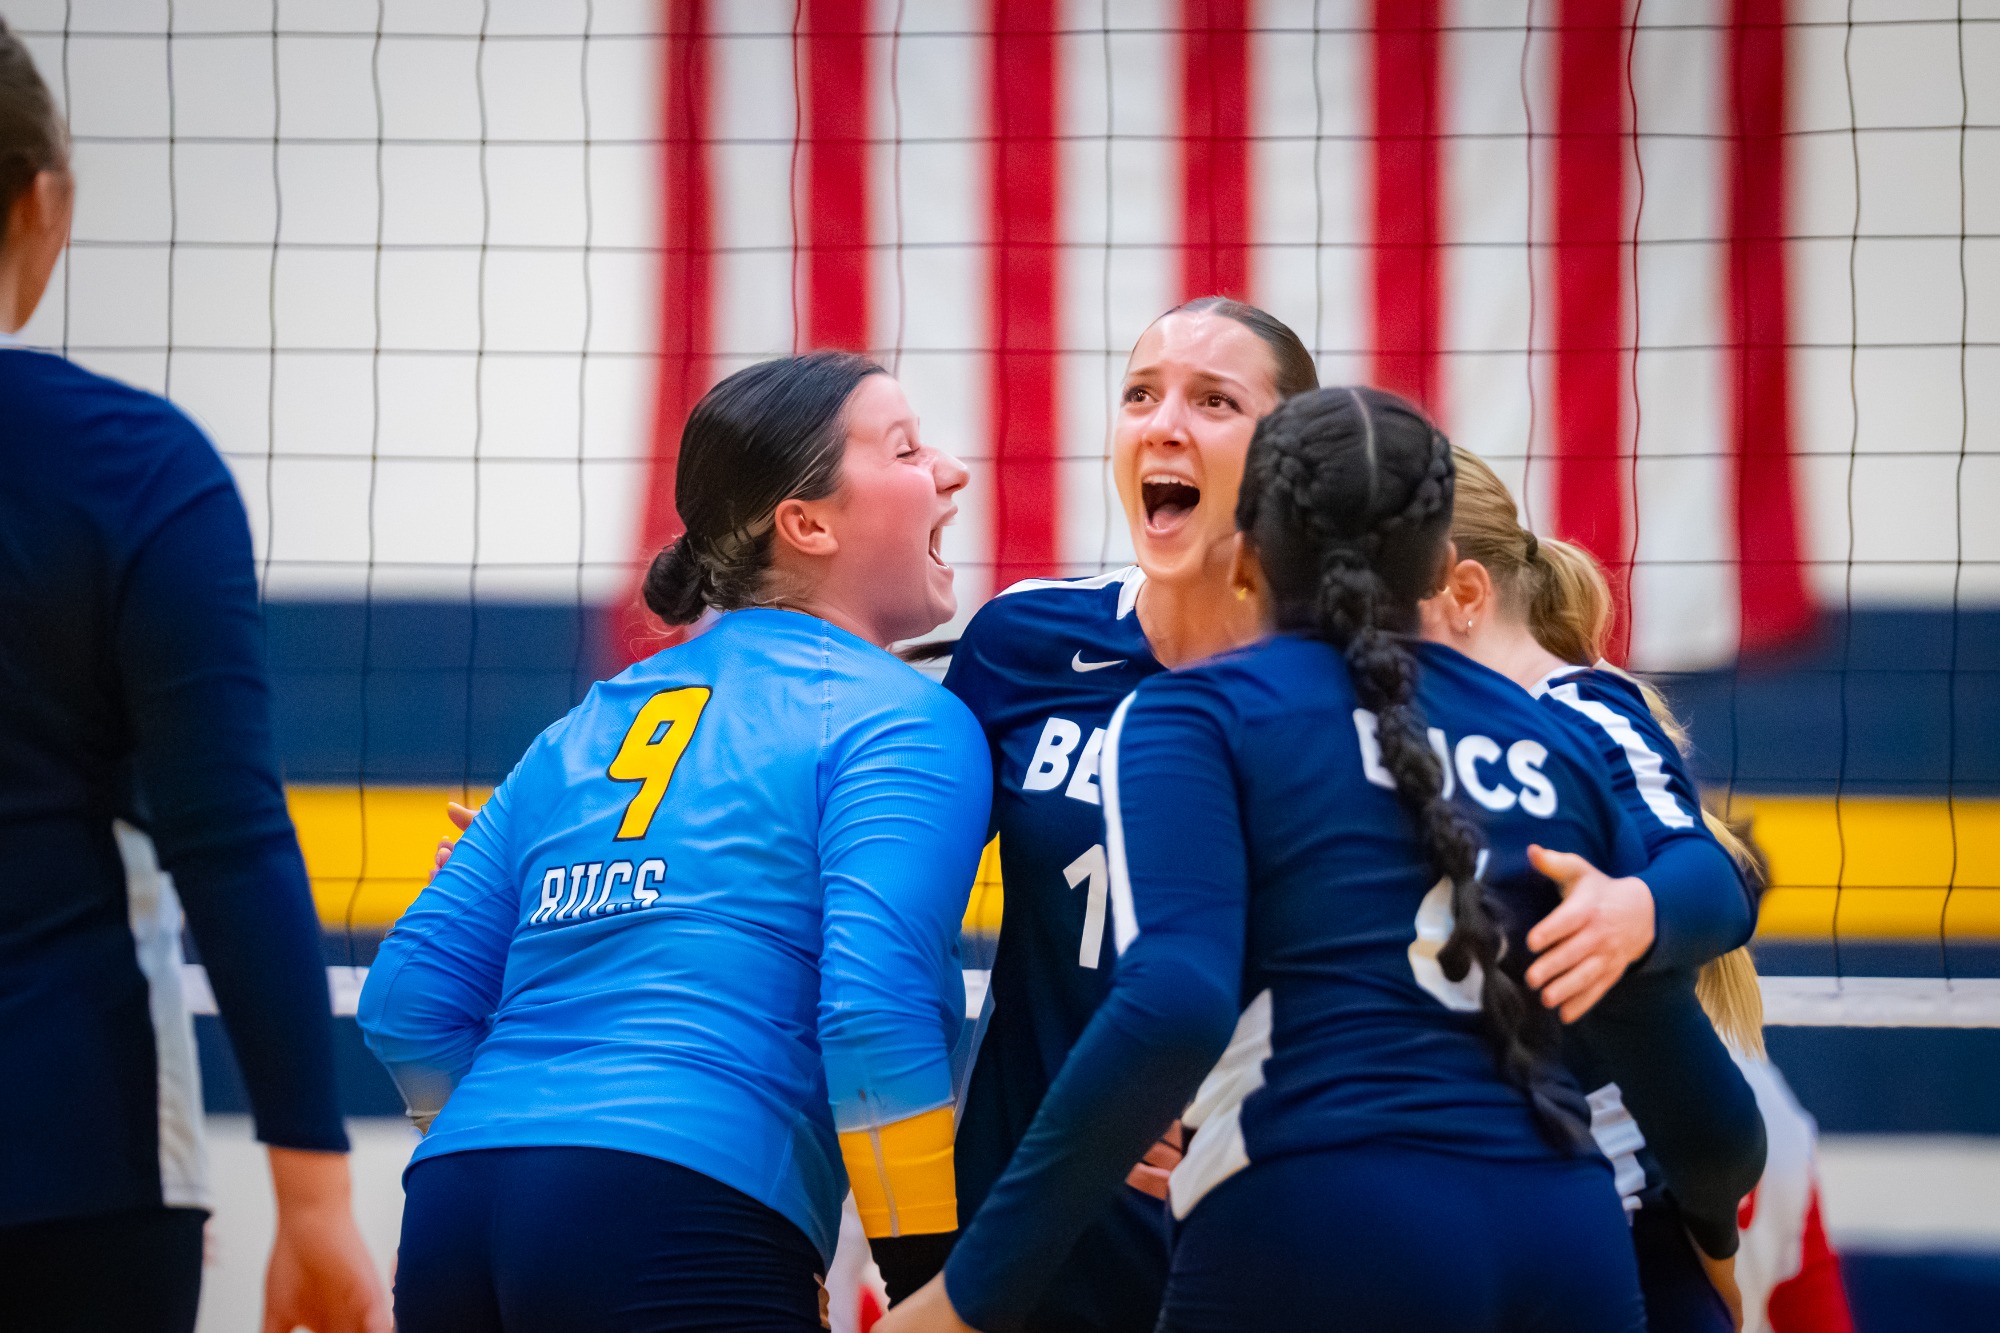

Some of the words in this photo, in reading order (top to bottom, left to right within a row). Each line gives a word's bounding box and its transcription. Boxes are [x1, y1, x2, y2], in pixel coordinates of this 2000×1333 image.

[606, 684, 713, 842] 9
[528, 857, 668, 926] BUCS
[1062, 843, 1108, 969] 1
